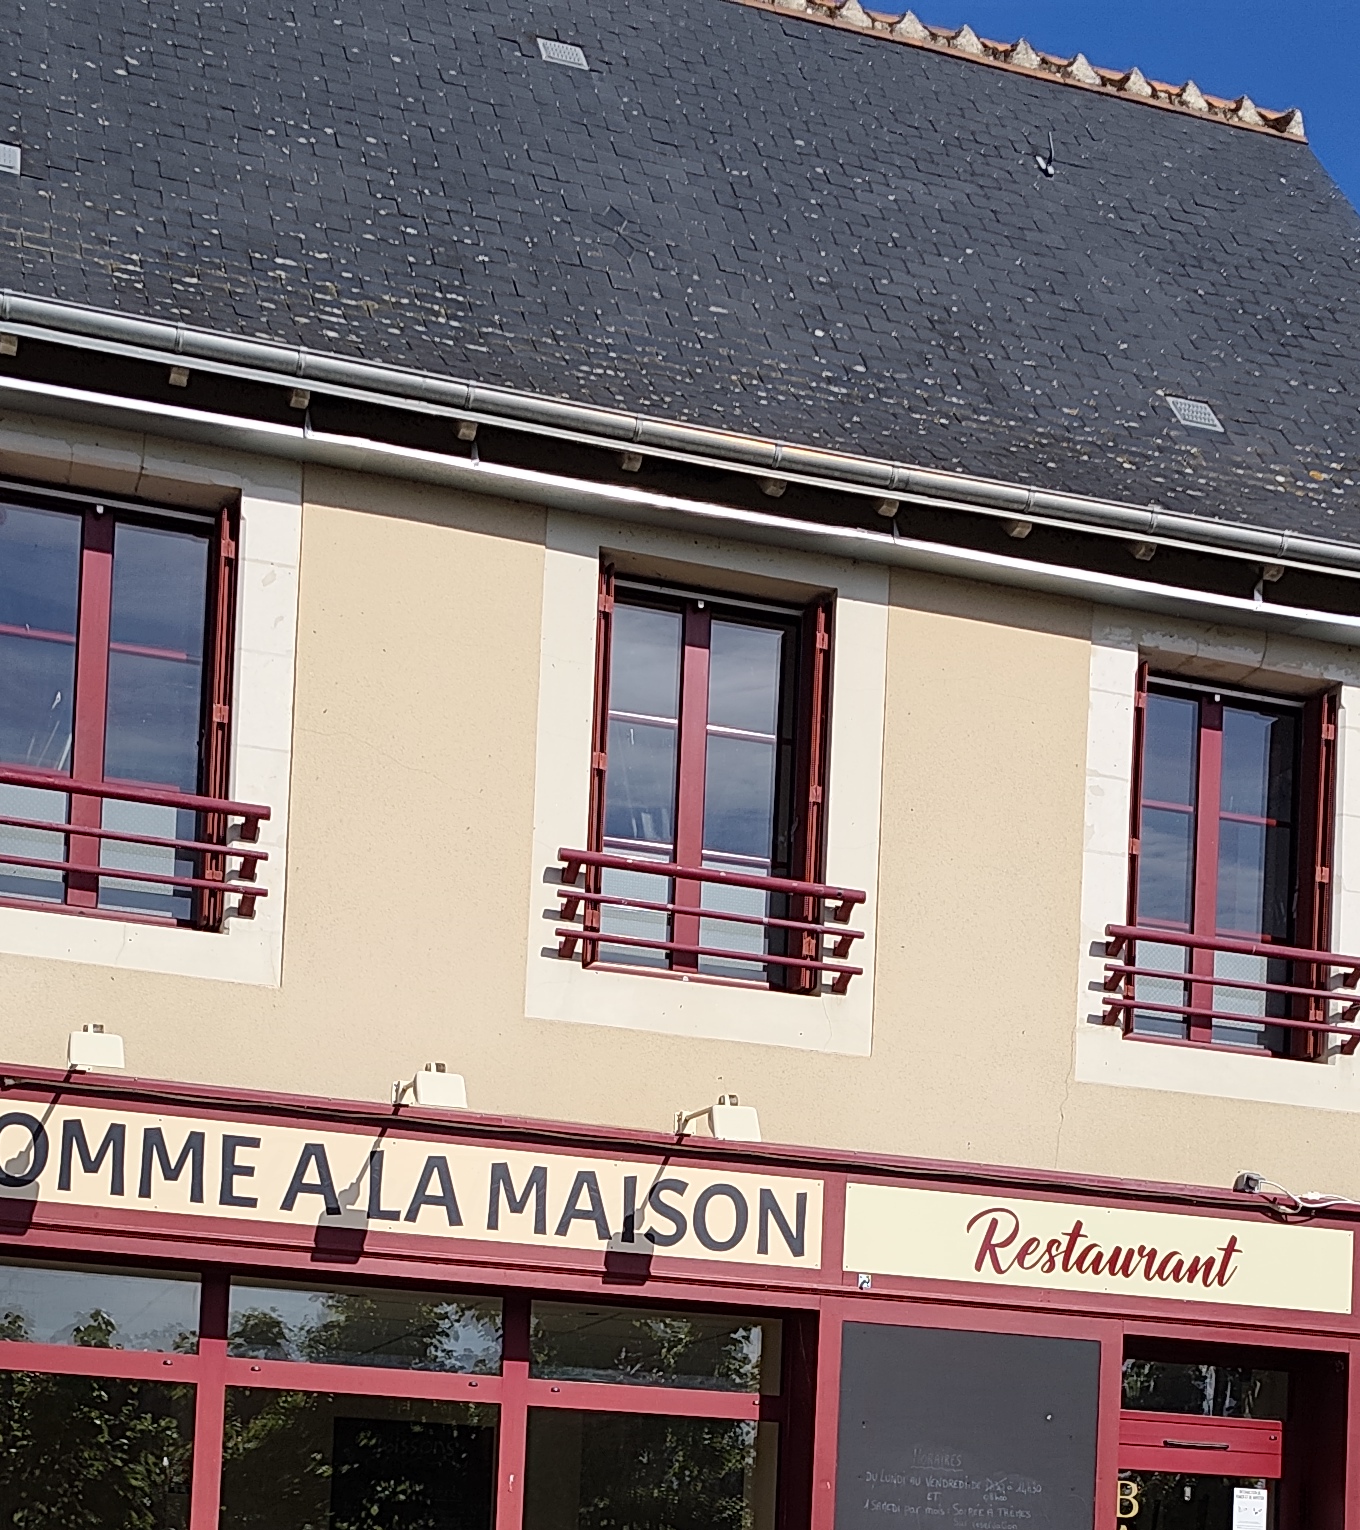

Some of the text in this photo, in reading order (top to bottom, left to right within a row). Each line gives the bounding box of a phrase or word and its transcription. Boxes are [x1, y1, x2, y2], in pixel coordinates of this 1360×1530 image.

[280, 1143, 355, 1218] A
[366, 1149, 464, 1227] LA
[486, 1161, 808, 1257] MAISON
[966, 1207, 1243, 1287] Restaurant
[904, 1505, 922, 1516] par
[927, 1491, 942, 1502] ET
